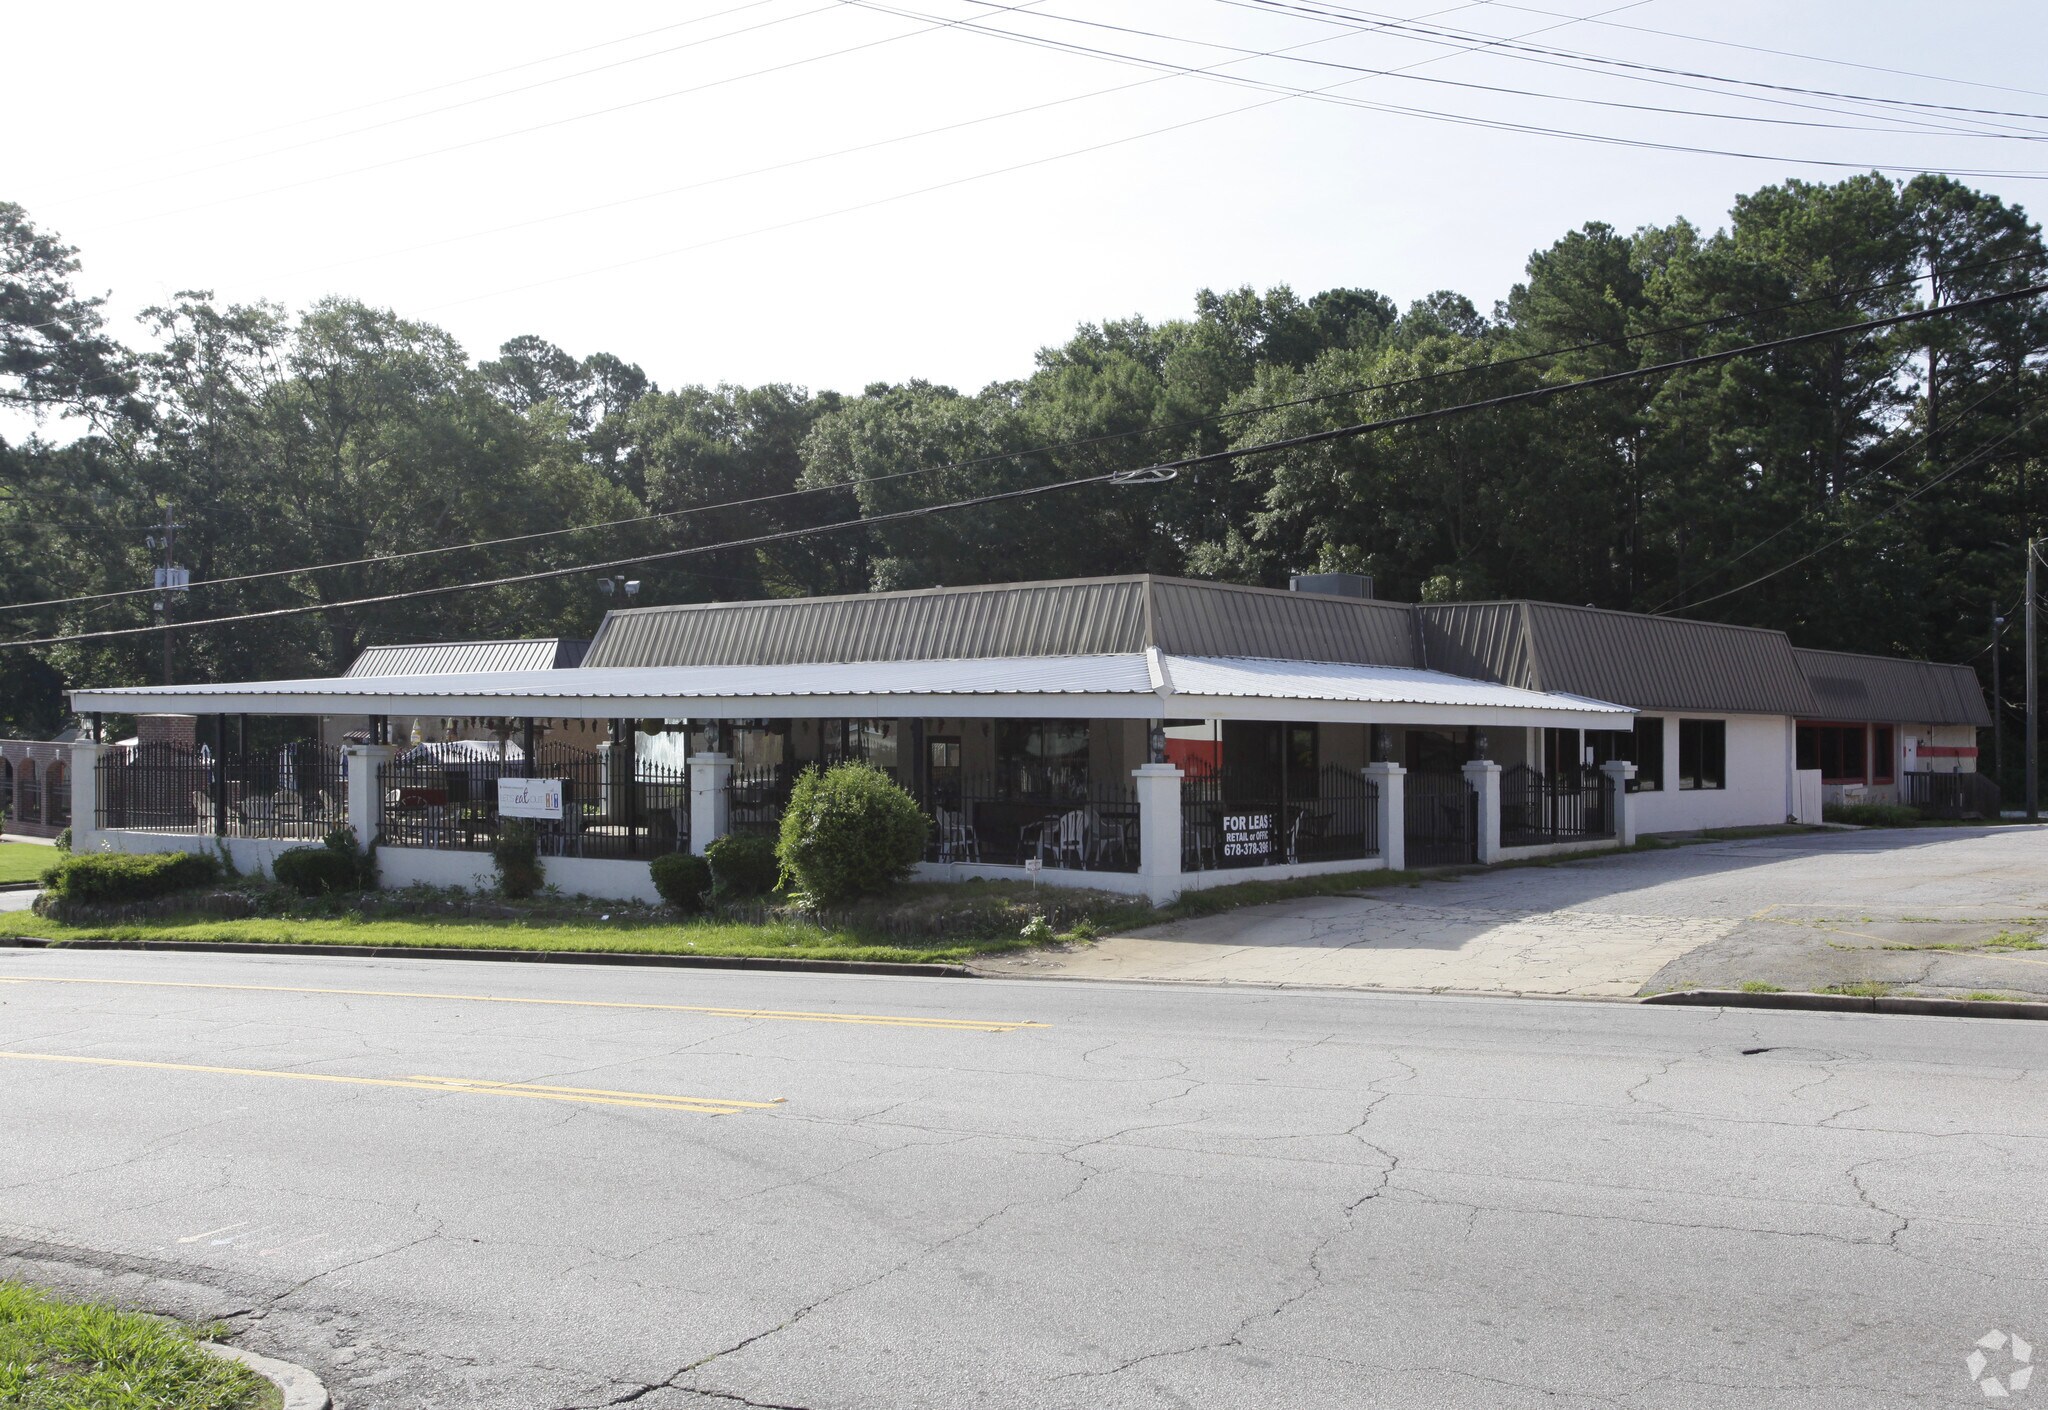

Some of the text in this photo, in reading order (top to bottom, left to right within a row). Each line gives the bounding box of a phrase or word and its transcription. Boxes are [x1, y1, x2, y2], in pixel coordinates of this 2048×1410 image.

[515, 786, 530, 804] eat
[1223, 816, 1246, 831] FOR
[1226, 832, 1249, 842] RETAIL
